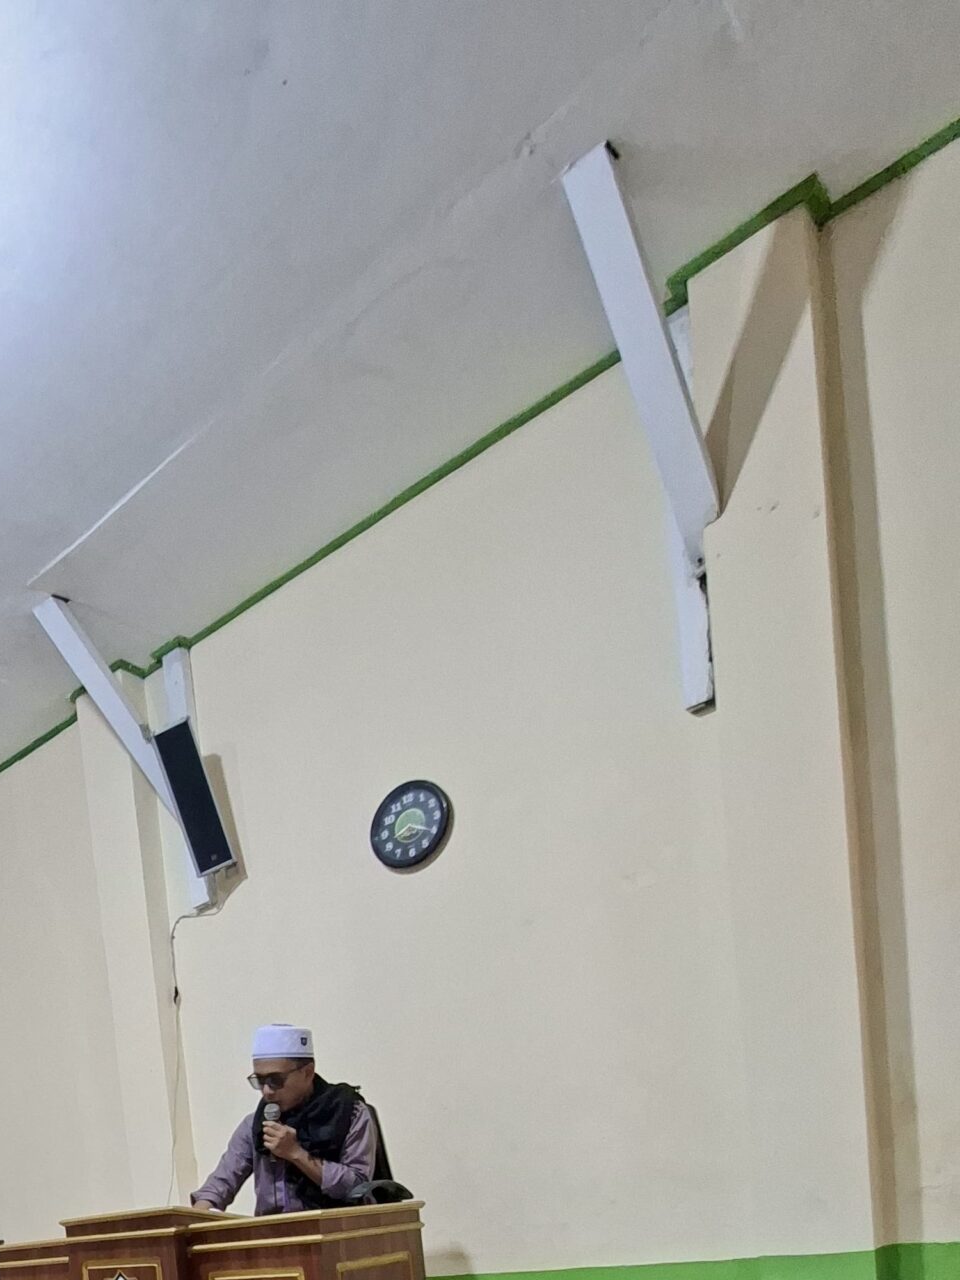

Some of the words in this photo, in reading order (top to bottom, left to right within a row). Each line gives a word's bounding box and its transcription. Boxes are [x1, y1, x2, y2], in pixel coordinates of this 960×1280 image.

[402, 793, 414, 804] 12
[419, 792, 425, 802] 1
[391, 802, 402, 813] 11
[428, 798, 436, 808] 2
[384, 814, 396, 826] 10
[433, 810, 441, 820] 3
[381, 829, 389, 840] 9
[422, 838, 430, 848] 5
[395, 848, 402, 859] 7
[408, 848, 416, 858] 6
